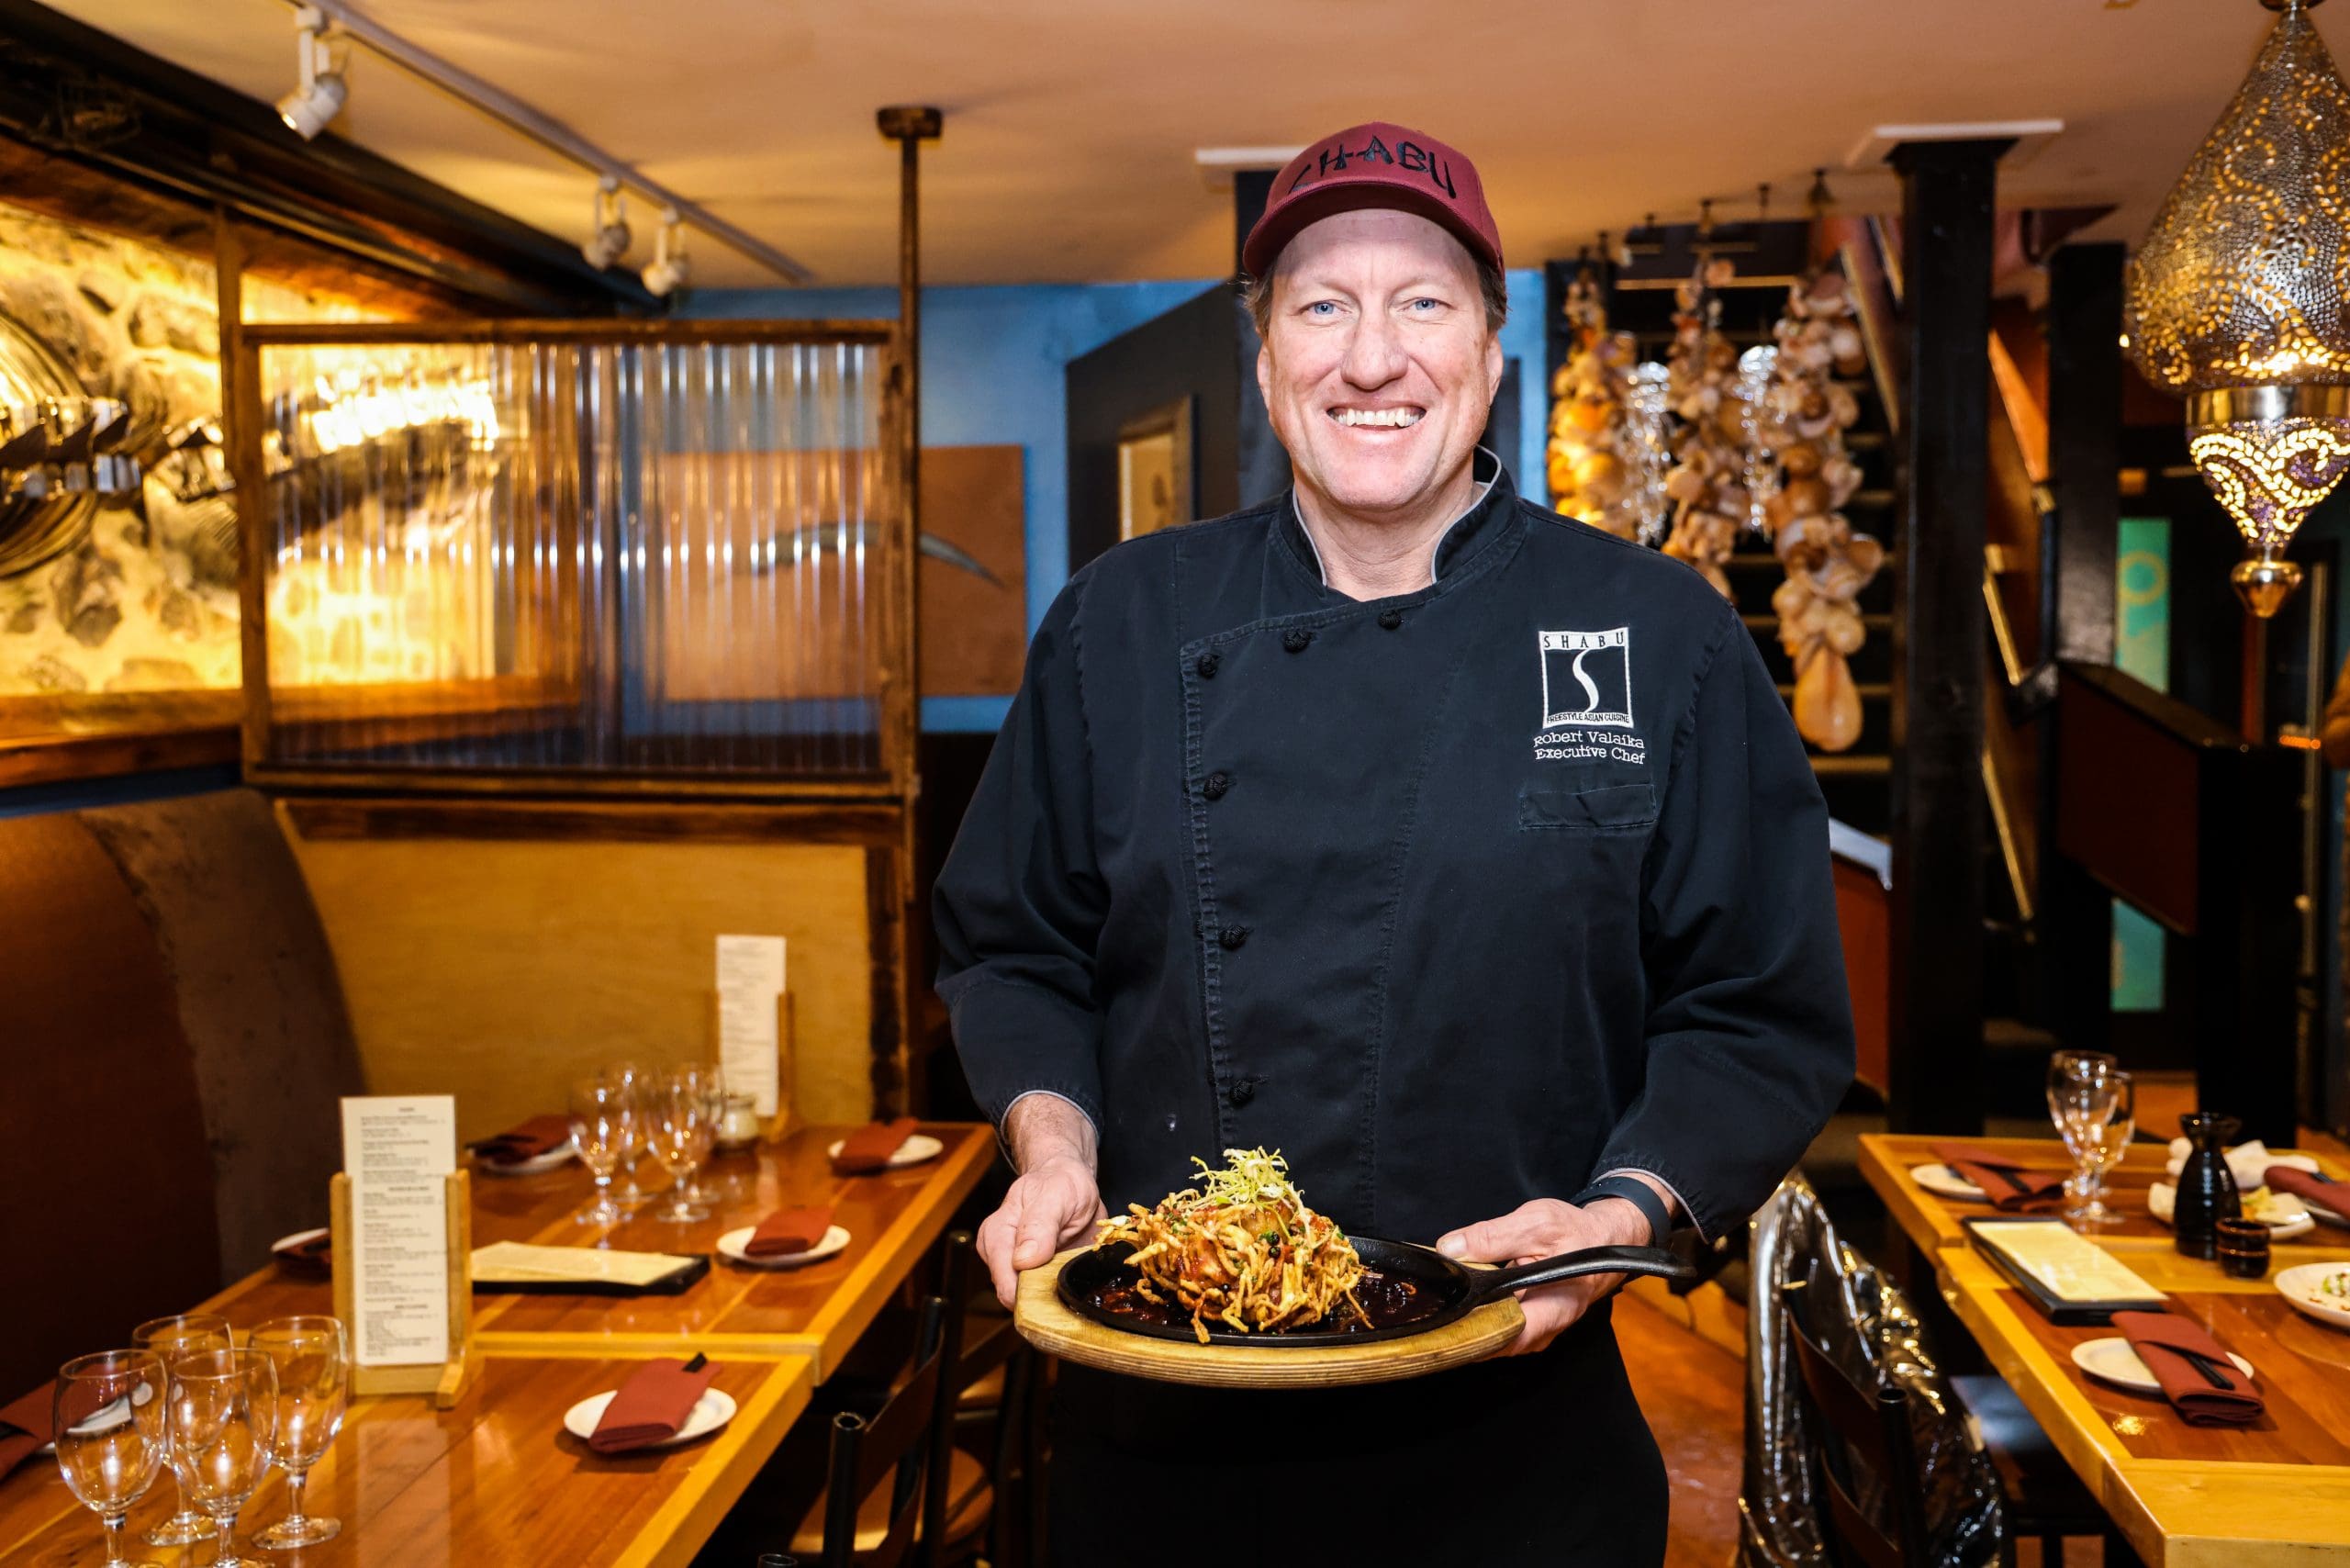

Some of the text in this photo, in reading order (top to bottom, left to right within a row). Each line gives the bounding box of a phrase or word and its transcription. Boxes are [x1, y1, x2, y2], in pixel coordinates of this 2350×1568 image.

[1544, 632, 1624, 648] SHABU
[1547, 713, 1629, 723] FREESTYLE ASIAN CUISINE
[1533, 730, 1645, 749] Robert Valaika
[1535, 745, 1646, 765] Executive Chef
